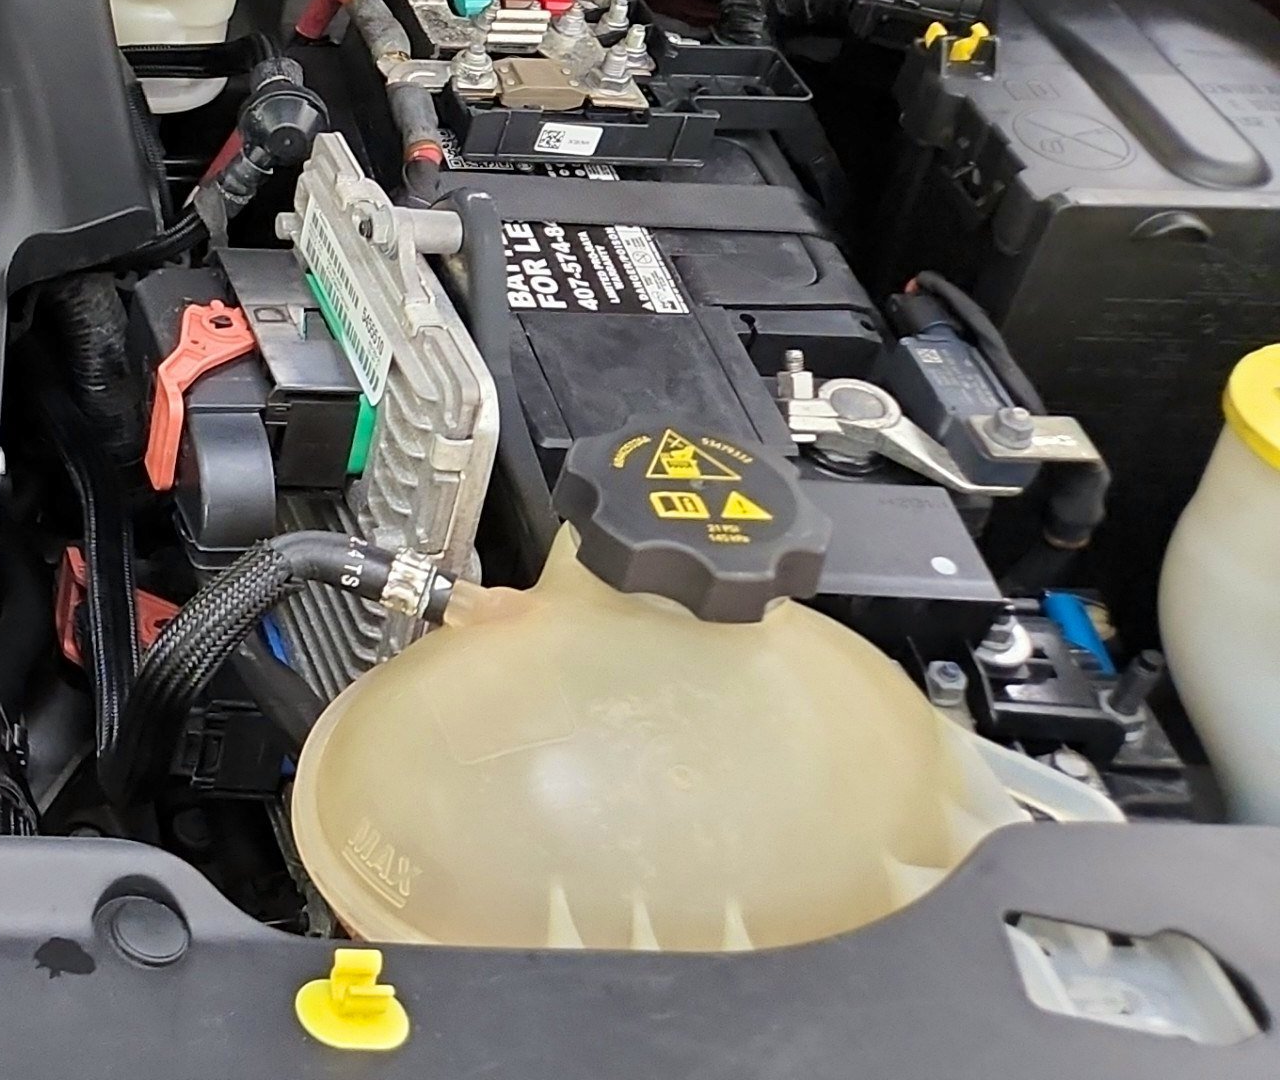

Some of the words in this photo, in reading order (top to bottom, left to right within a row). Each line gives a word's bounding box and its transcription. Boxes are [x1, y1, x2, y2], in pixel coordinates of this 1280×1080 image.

[577, 230, 603, 270] PRO-RATA
[595, 245, 625, 290] WARRANTY
[522, 258, 568, 309] FOR
[596, 269, 622, 304] LIMITED
[344, 816, 422, 897] MAX
